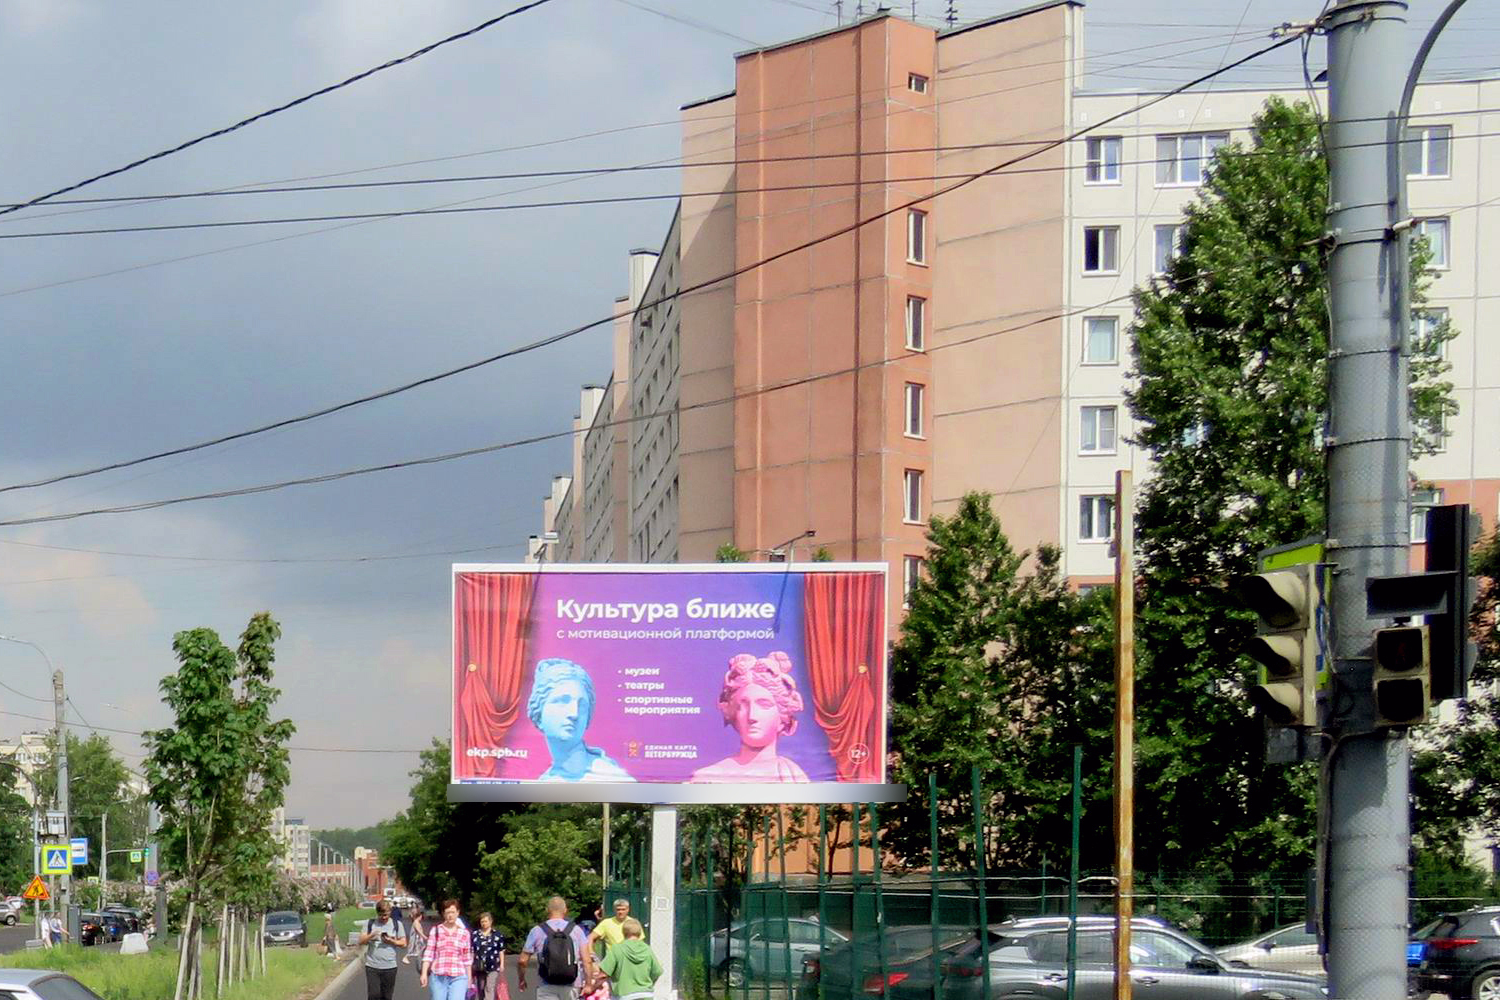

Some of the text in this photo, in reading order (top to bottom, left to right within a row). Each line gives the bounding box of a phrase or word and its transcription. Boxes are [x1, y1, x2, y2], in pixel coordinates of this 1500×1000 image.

[556, 598, 776, 623] Культура ближе
[556, 627, 775, 641] с мотивационной платформой
[625, 668, 660, 677] музеи
[624, 682, 665, 691] театры
[624, 696, 693, 705] спортивные
[624, 706, 701, 716] мероприятия
[466, 747, 528, 759] ekp.spb.ru
